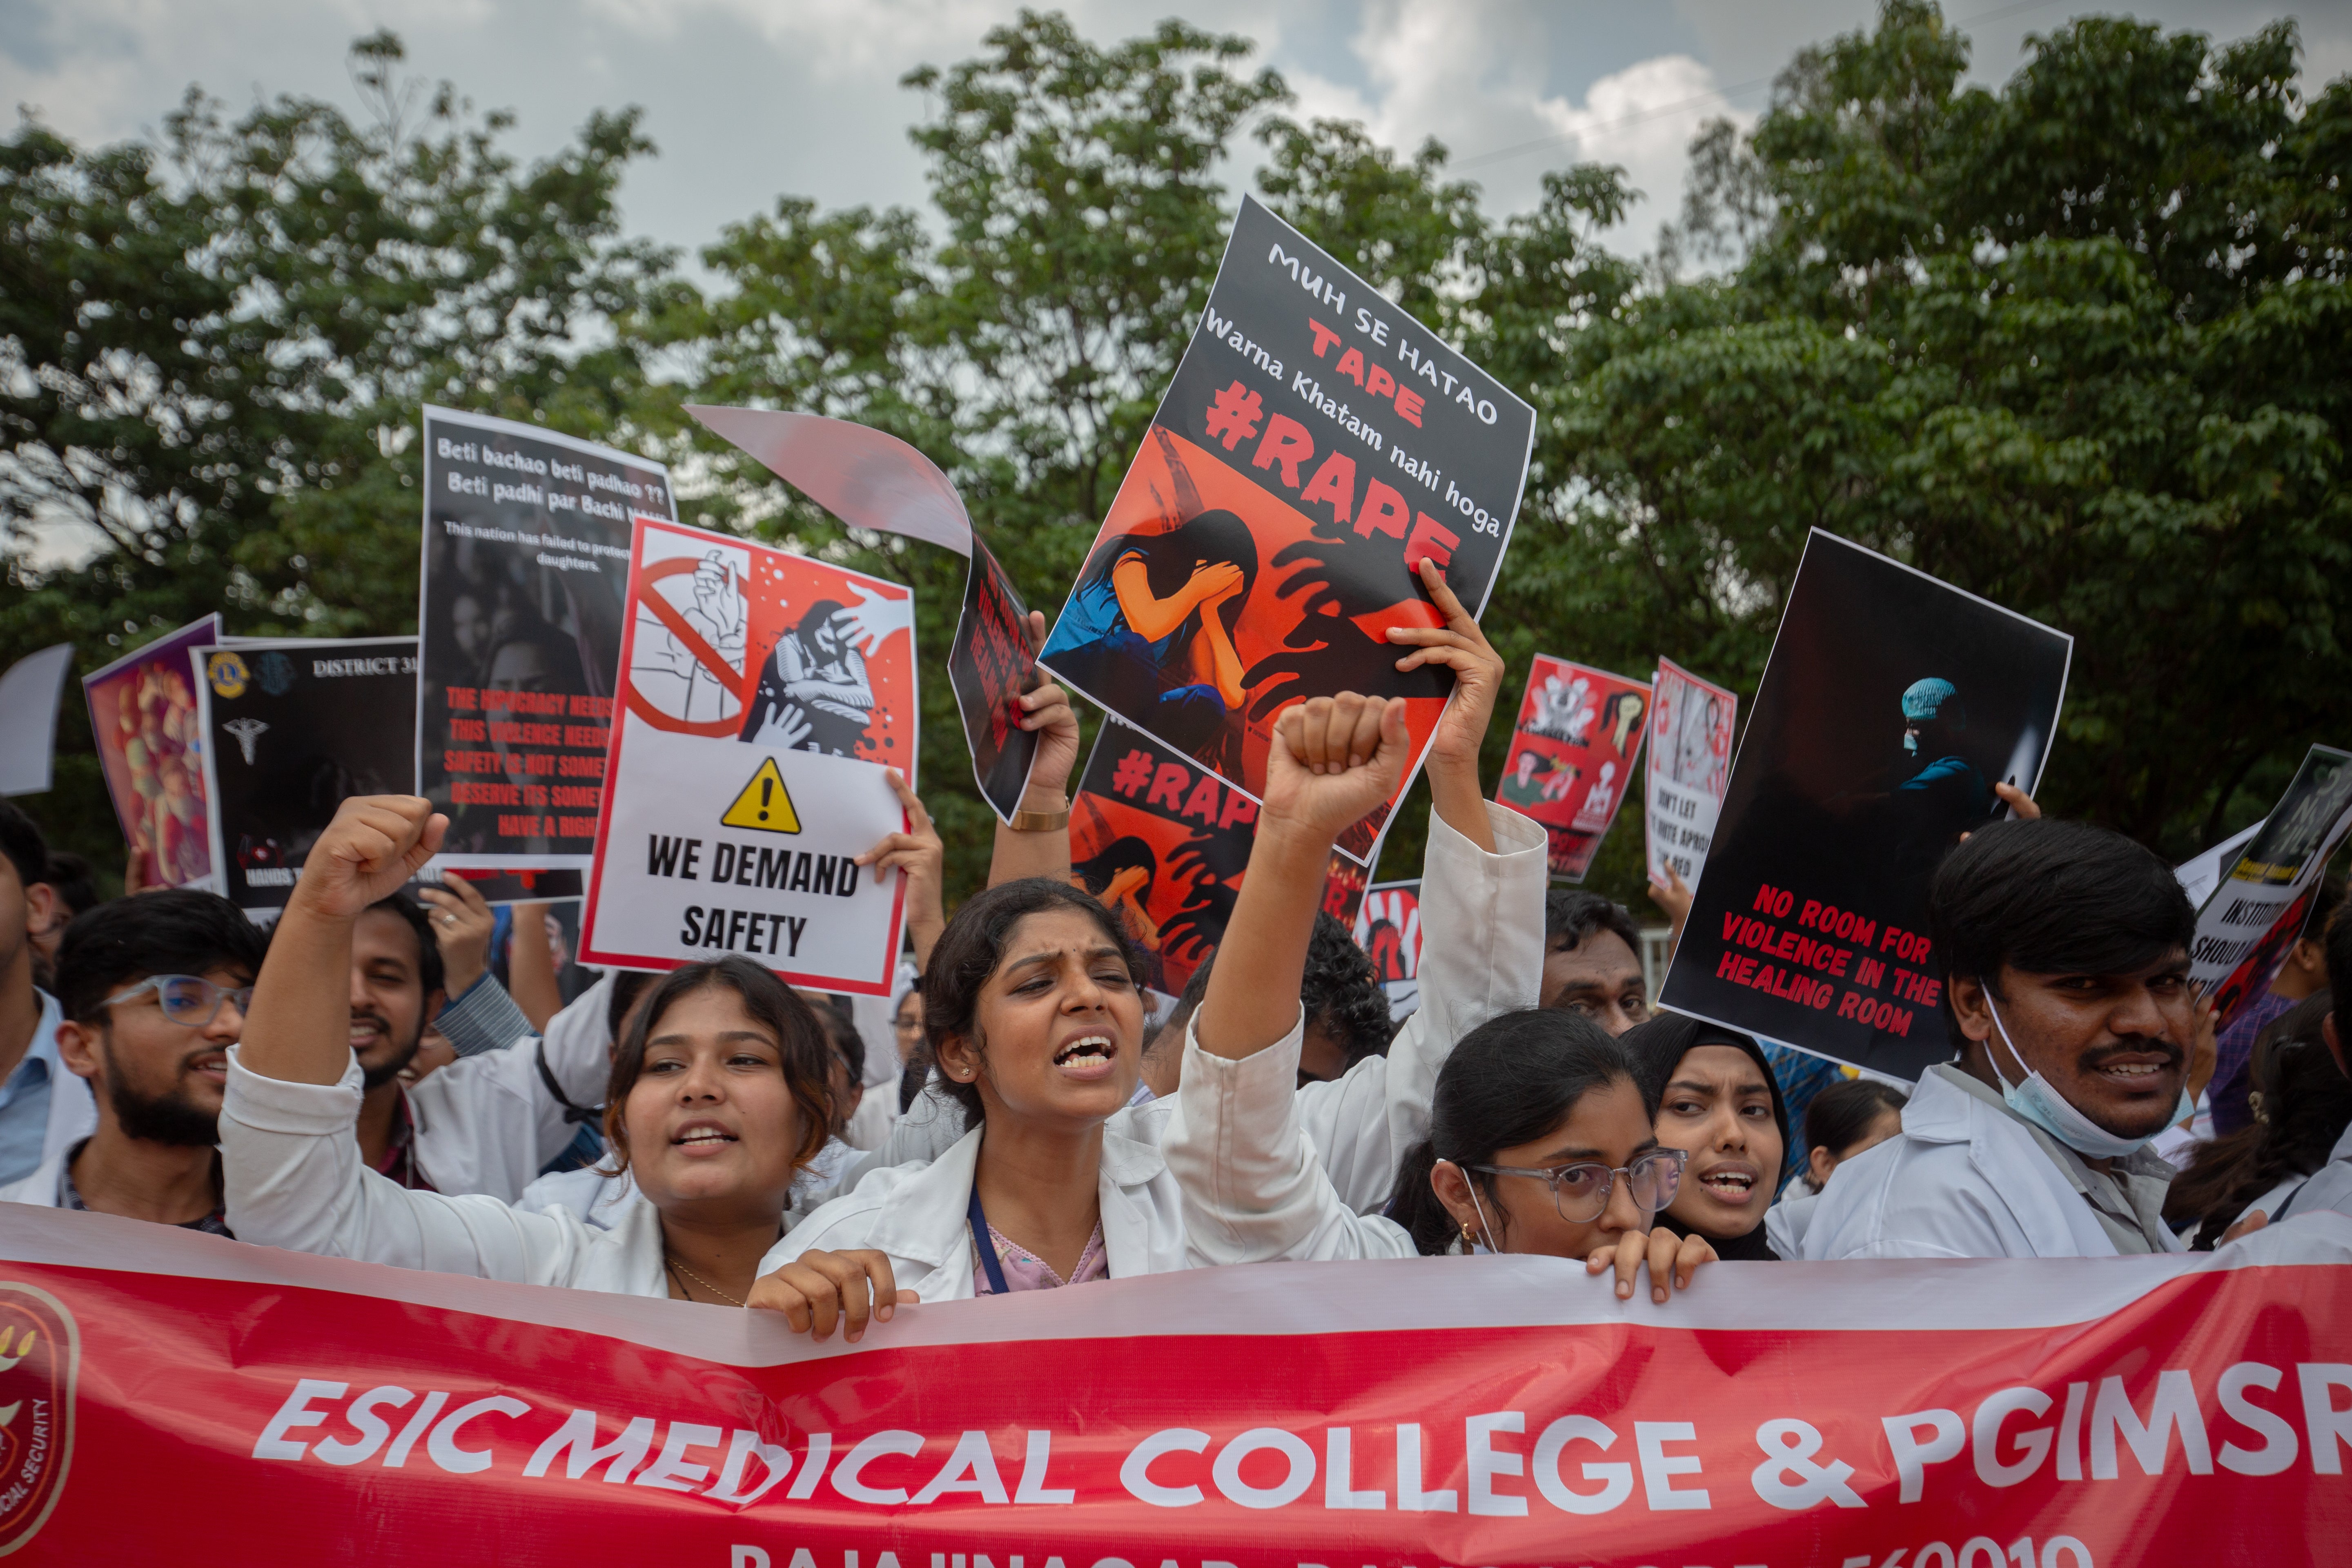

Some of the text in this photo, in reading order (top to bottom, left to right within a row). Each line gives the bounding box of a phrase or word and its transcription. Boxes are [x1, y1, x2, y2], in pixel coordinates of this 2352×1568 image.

[1268, 243, 1497, 425] MUH SE HATAO
[1309, 317, 1425, 428] TAPE
[1207, 307, 1499, 538] Warna Khatam nahi hoga
[437, 437, 477, 463] Beti
[482, 445, 548, 475] bachao
[551, 458, 584, 483] beti
[587, 469, 643, 499] padhao
[448, 472, 488, 497] Beti
[493, 483, 543, 505] padhi
[548, 492, 576, 512] par
[581, 494, 625, 522] Bachi
[1206, 380, 1461, 584] #RAPE
[444, 520, 473, 536] This
[474, 524, 515, 542] nation
[518, 530, 541, 546] has
[541, 533, 575, 551] failed
[577, 539, 591, 554] to
[312, 657, 398, 678] DISTRICT
[446, 686, 478, 711] THE
[444, 749, 606, 778] SAFETY IS NOT SOME
[449, 718, 486, 742] THIS
[489, 720, 562, 746] VIOLENCE
[451, 782, 521, 806] DESERVE
[1113, 749, 1260, 837] #RAP
[498, 814, 540, 837] HAVE
[543, 815, 557, 837] A
[246, 868, 295, 887] HANDS
[647, 833, 859, 898] WE DEMAND
[679, 904, 807, 957] SAFETY
[1753, 884, 1931, 965] NO ROOM FOR
[1722, 911, 1942, 1008] VIOLENCE IN THE
[1716, 951, 1914, 1038] HEALING ROOM
[0, 1399, 49, 1516] CIAL SECURITY
[251, 1378, 532, 1473] ESIC
[521, 1409, 1075, 1505] MEDICAL
[1119, 1411, 1711, 1517] COLLEGE
[1751, 1418, 1868, 1510] &
